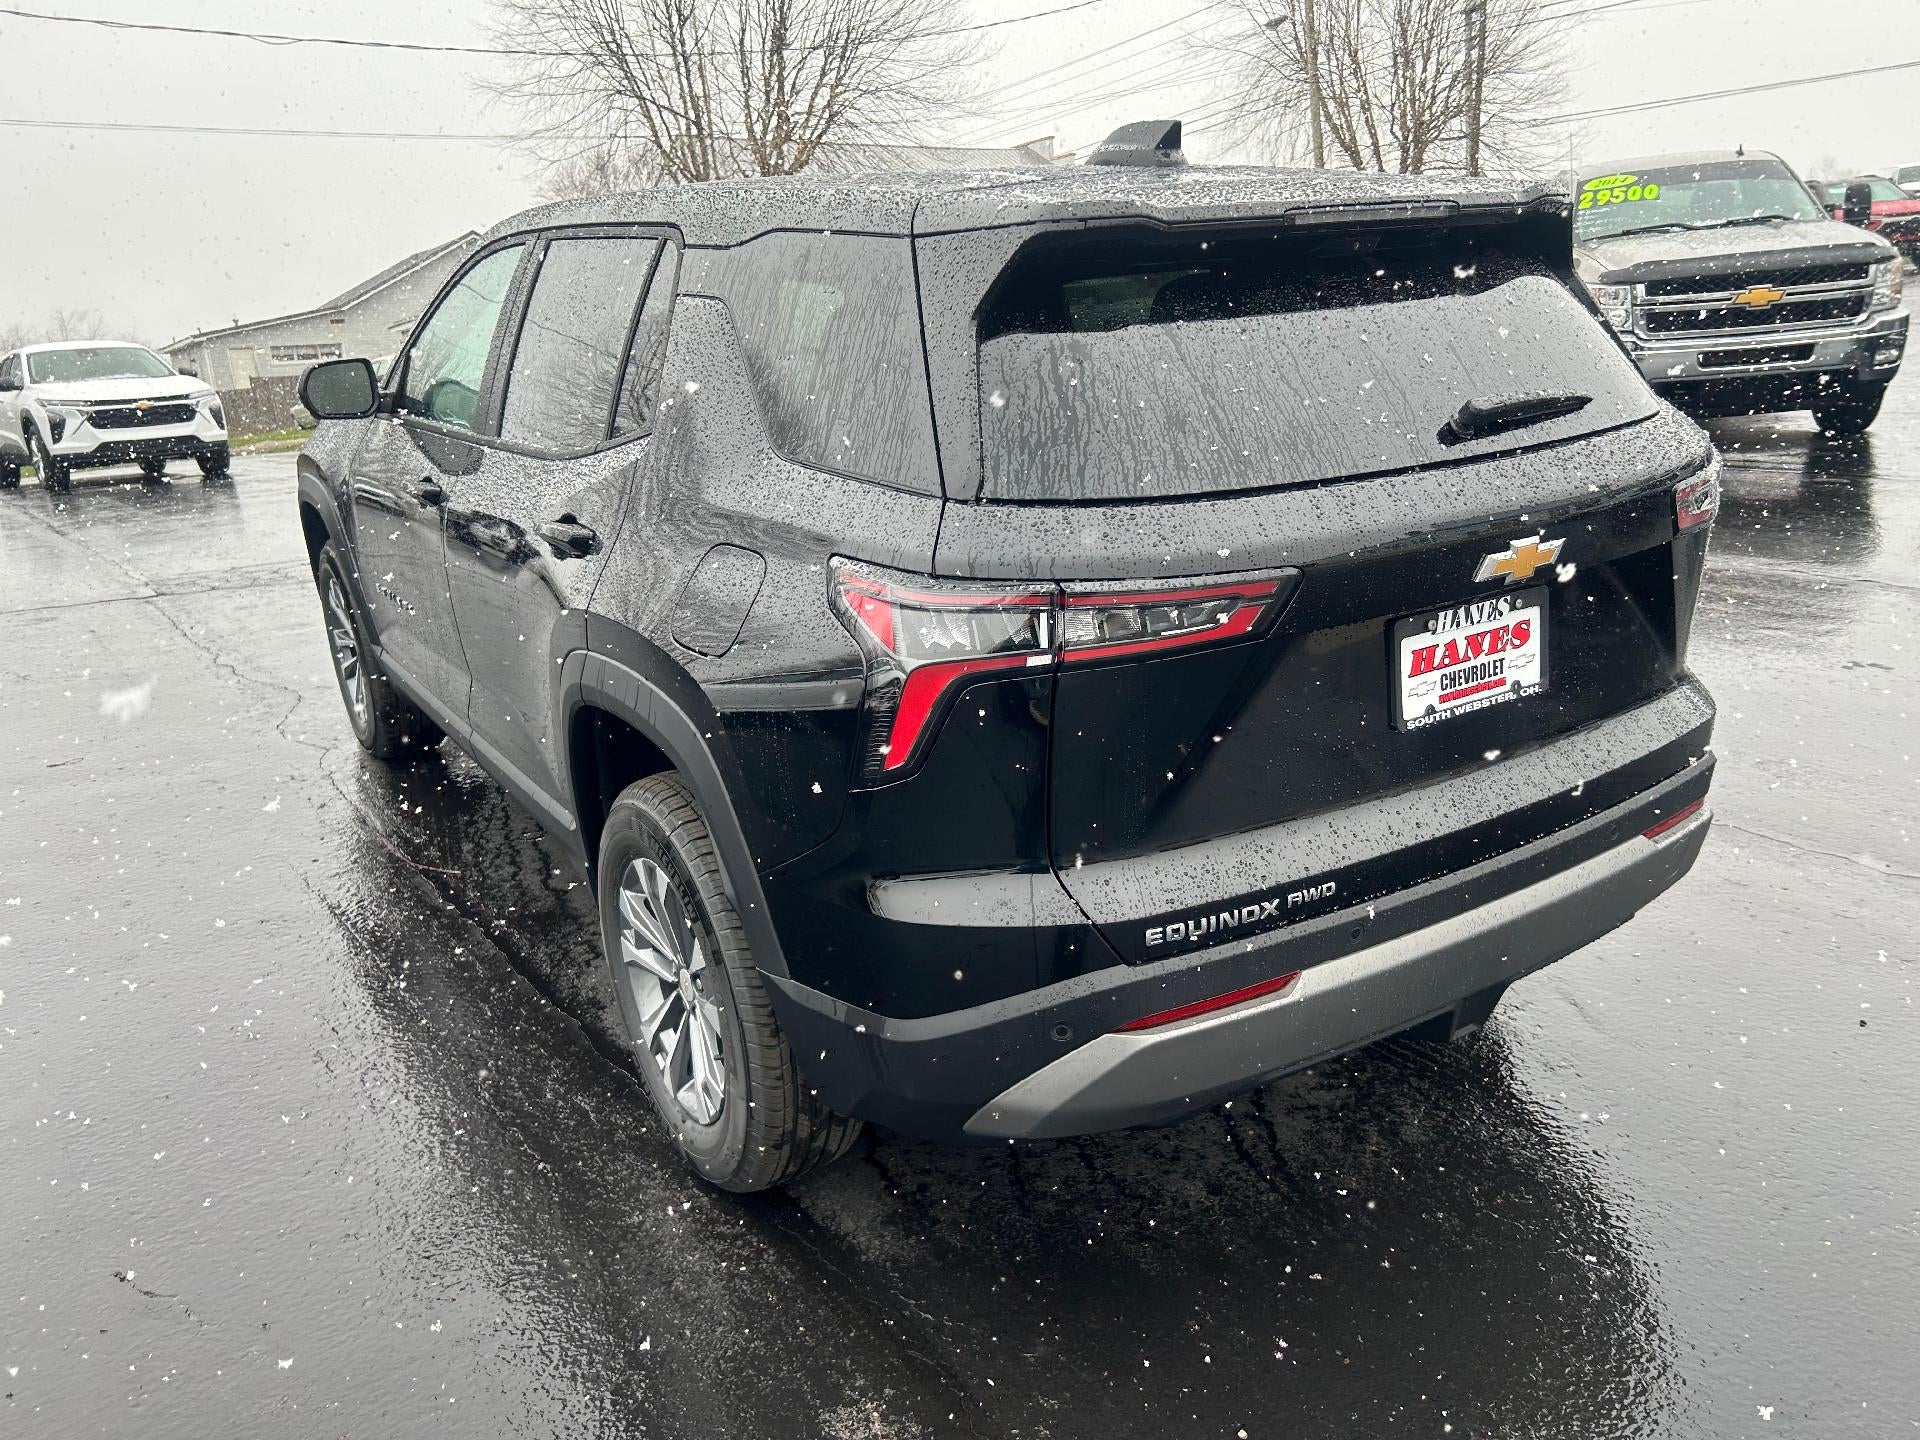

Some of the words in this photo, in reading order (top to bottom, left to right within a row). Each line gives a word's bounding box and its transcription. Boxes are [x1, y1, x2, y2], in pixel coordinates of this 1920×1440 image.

[1578, 184, 1660, 209] 29500
[1437, 595, 1511, 633] HANES
[1408, 618, 1531, 678] HANES
[1440, 657, 1505, 691] CHEVROLET
[1406, 709, 1451, 730] SOUTH
[1145, 898, 1280, 947] EQUINOX
[1287, 881, 1336, 909] AWD
